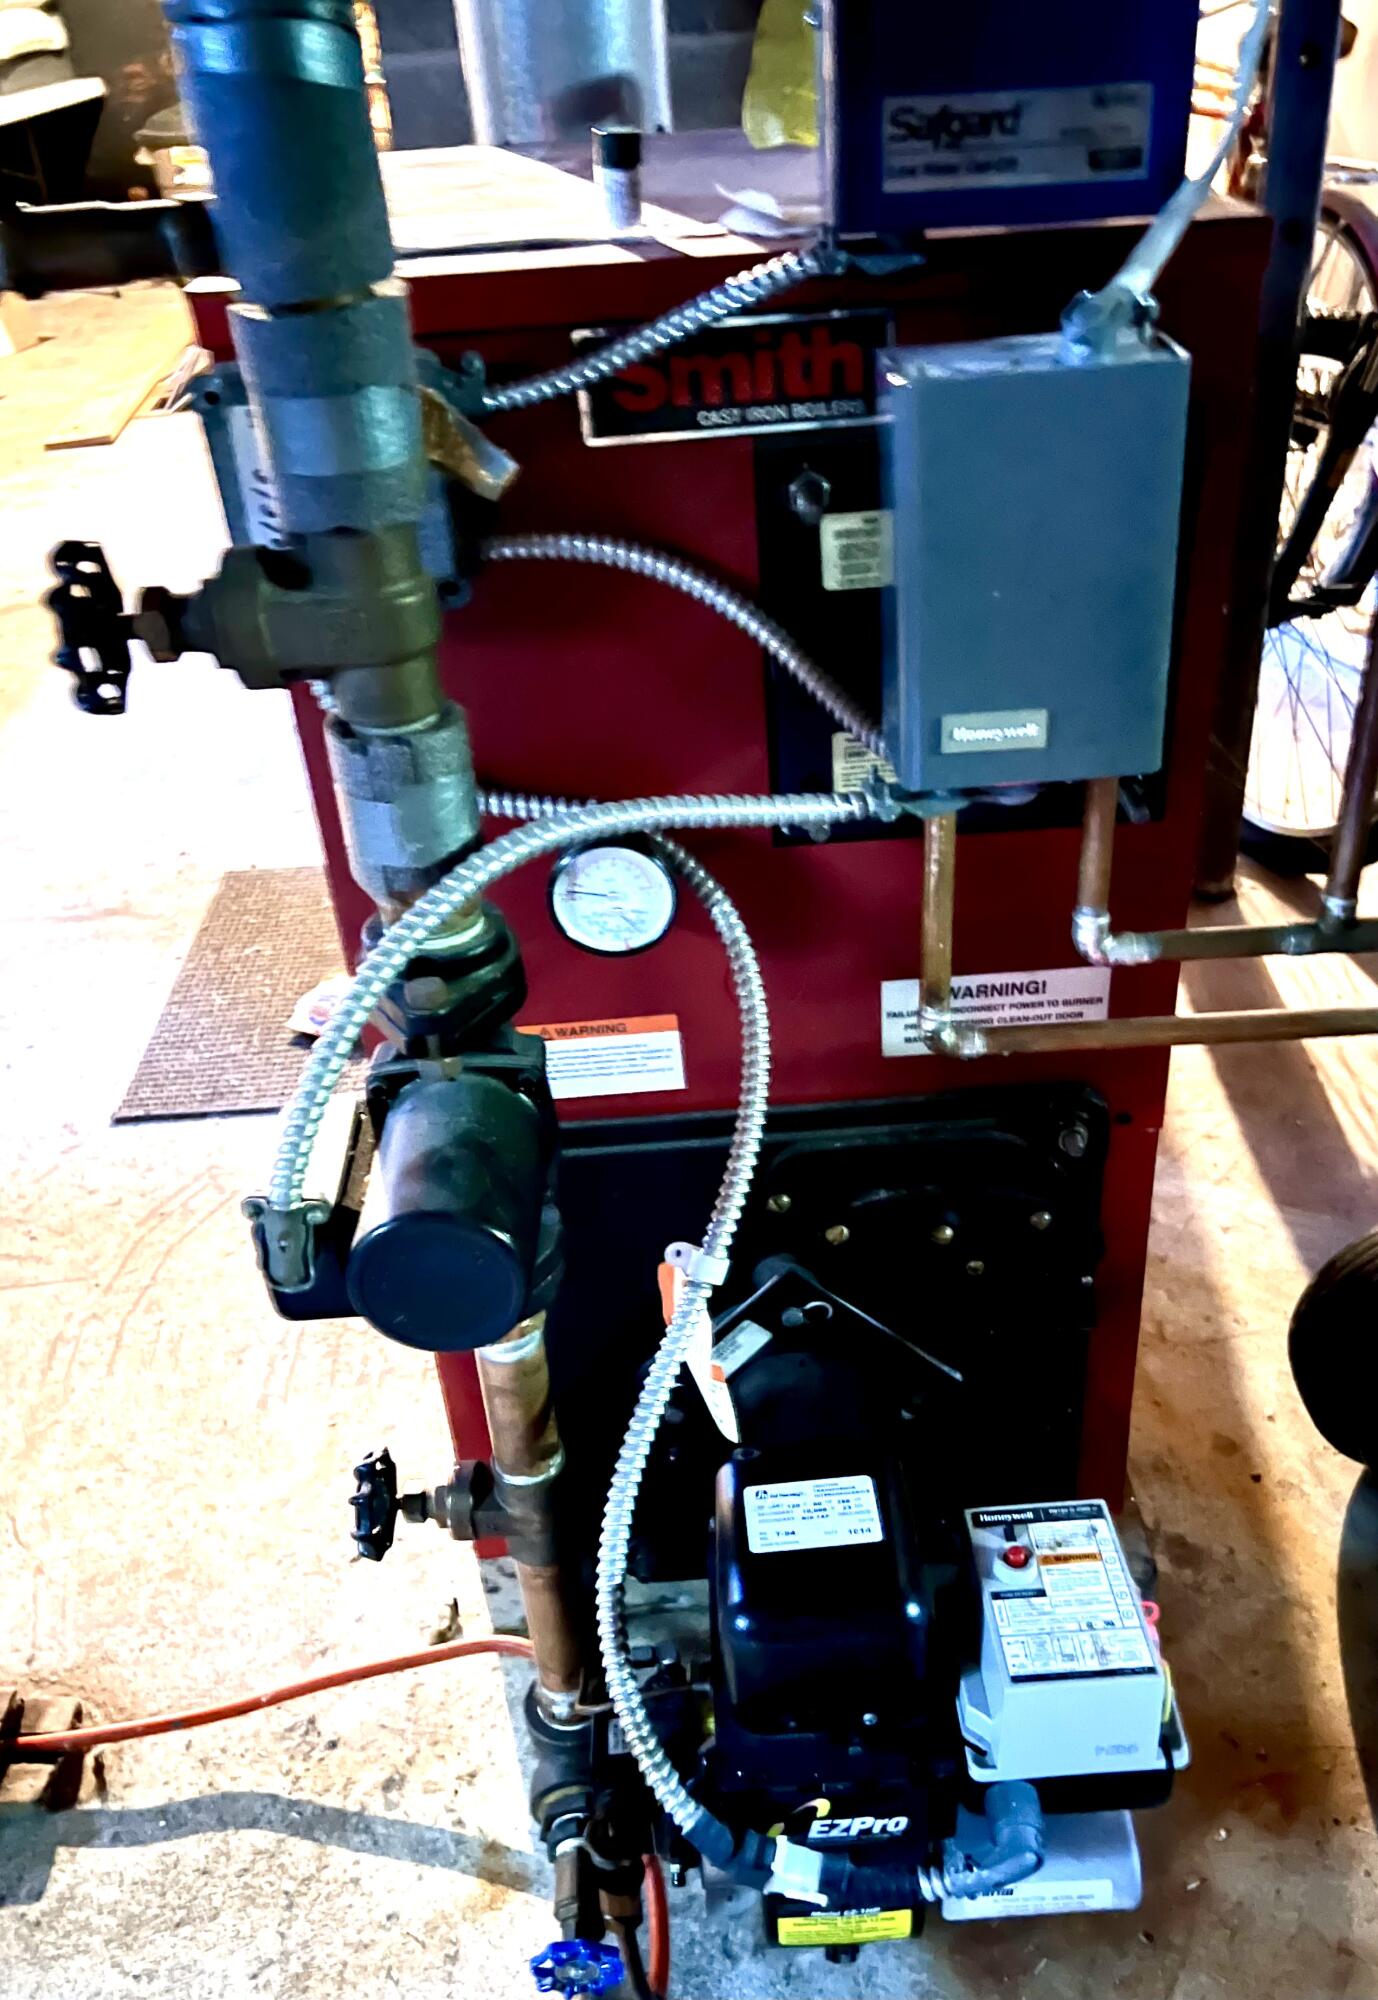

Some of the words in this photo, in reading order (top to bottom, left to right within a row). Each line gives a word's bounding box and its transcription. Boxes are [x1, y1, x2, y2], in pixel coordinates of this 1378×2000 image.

[612, 326, 863, 412] Smith
[697, 406, 741, 426] CAST
[745, 403, 790, 422] IRON
[952, 723, 1040, 741] Honeywell
[1009, 1000, 1044, 1010] POWER
[1047, 999, 1059, 1008] TO
[997, 1013, 1053, 1024] CLEAN-OUT
[554, 1022, 627, 1037] WARNING
[980, 1511, 1034, 1522] Honeywell
[808, 1816, 908, 1838] EZPro
